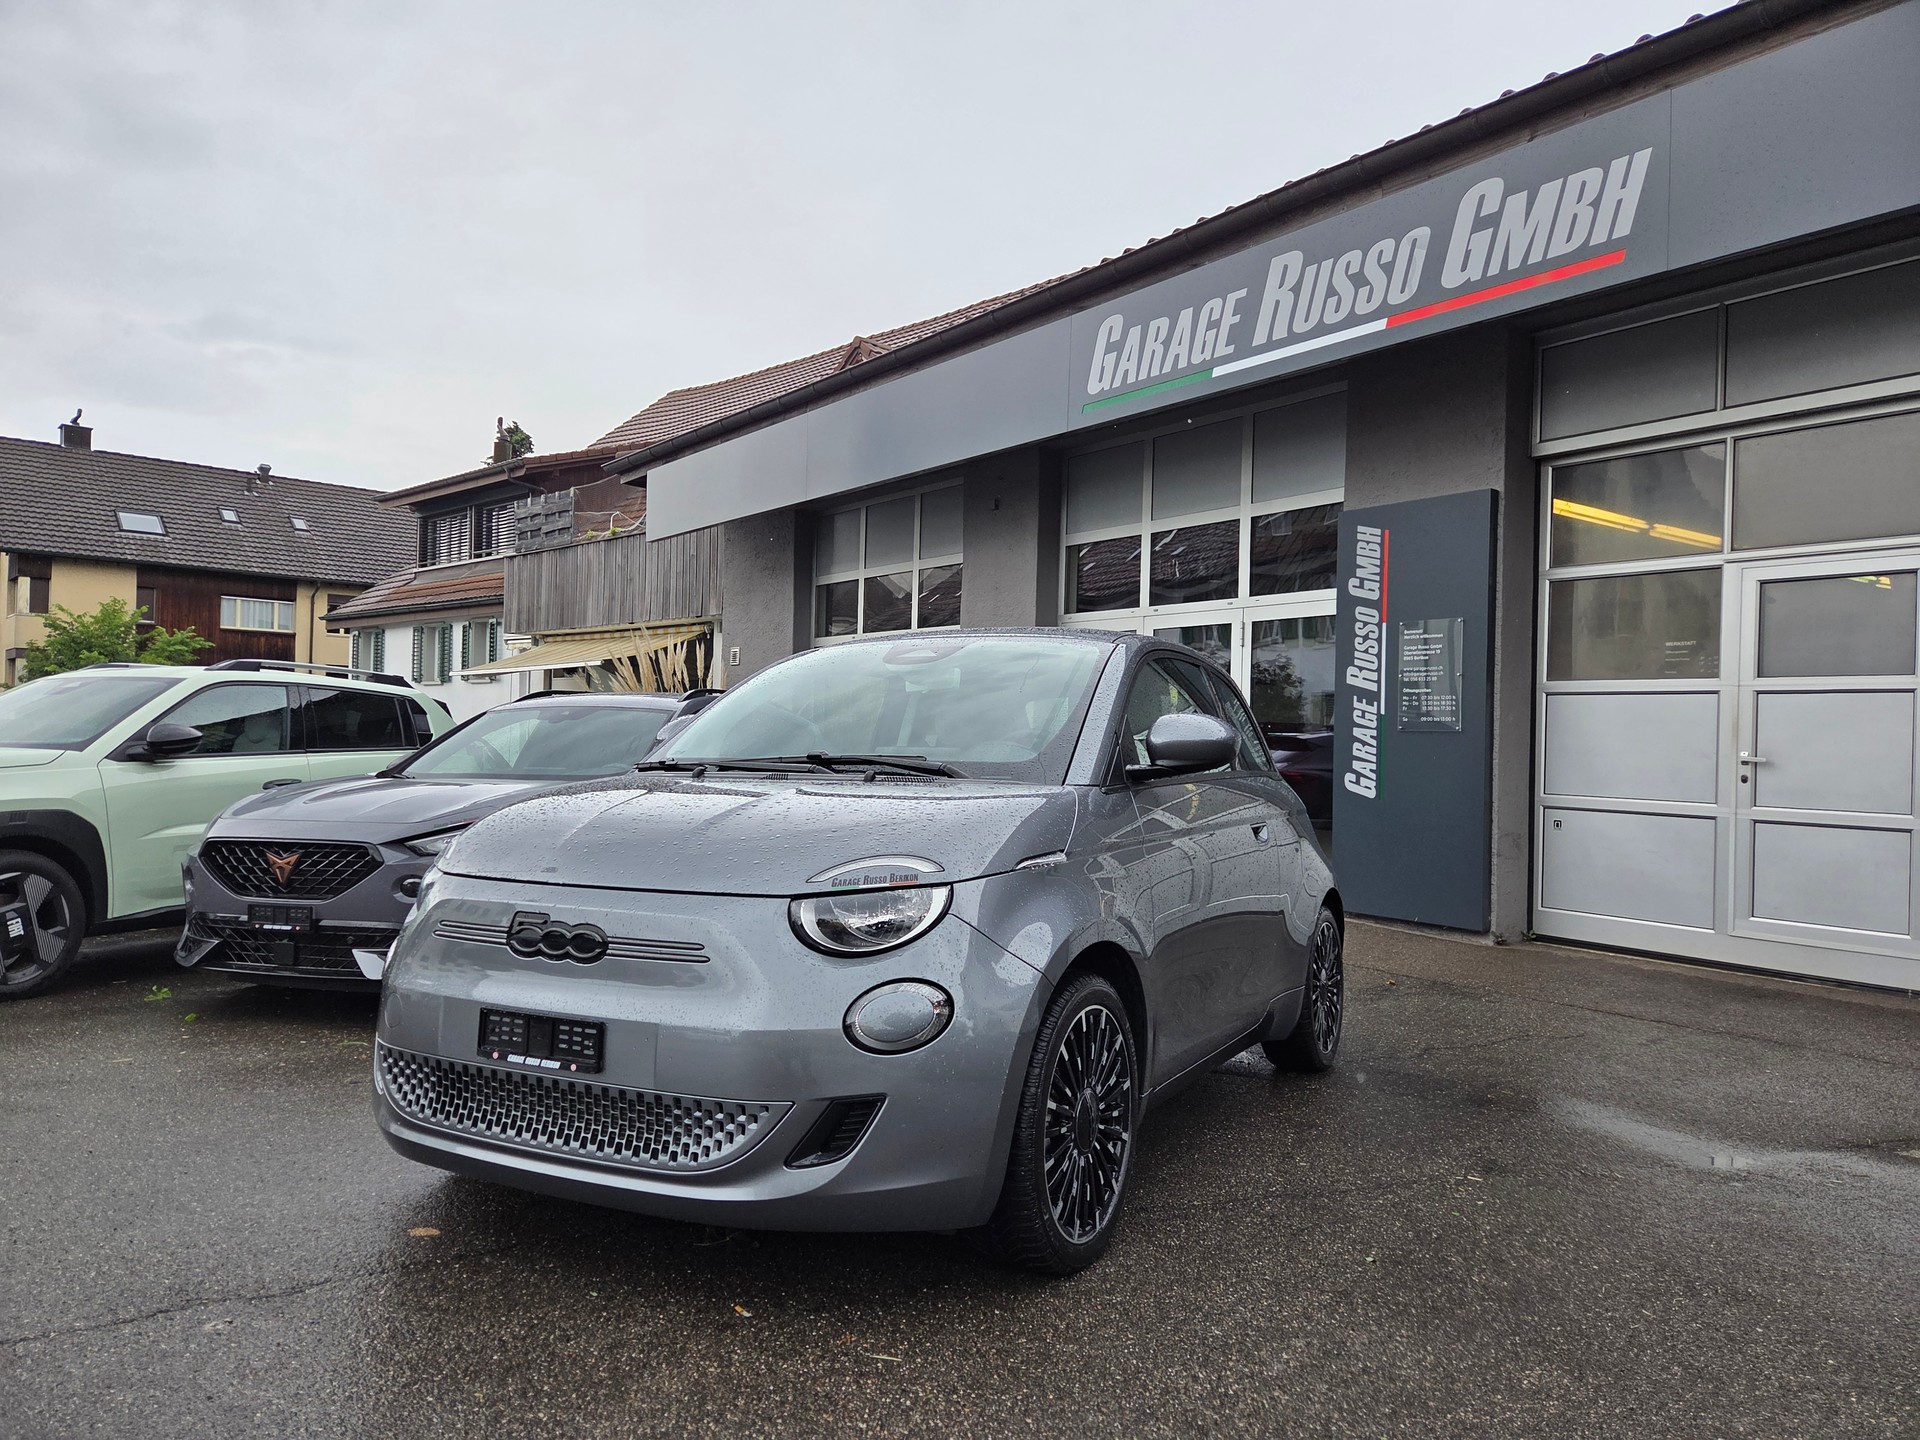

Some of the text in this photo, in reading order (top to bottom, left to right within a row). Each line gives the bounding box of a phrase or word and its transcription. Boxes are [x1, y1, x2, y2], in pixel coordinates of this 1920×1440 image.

[1087, 147, 1653, 394] GARAGE RUSSO GMBH
[1344, 525, 1382, 799] GARAGE RUSSO GMBH
[832, 873, 918, 887] GARAGE RUSSO BERIKON
[7, 917, 24, 938] FIAT
[508, 911, 608, 965] 500
